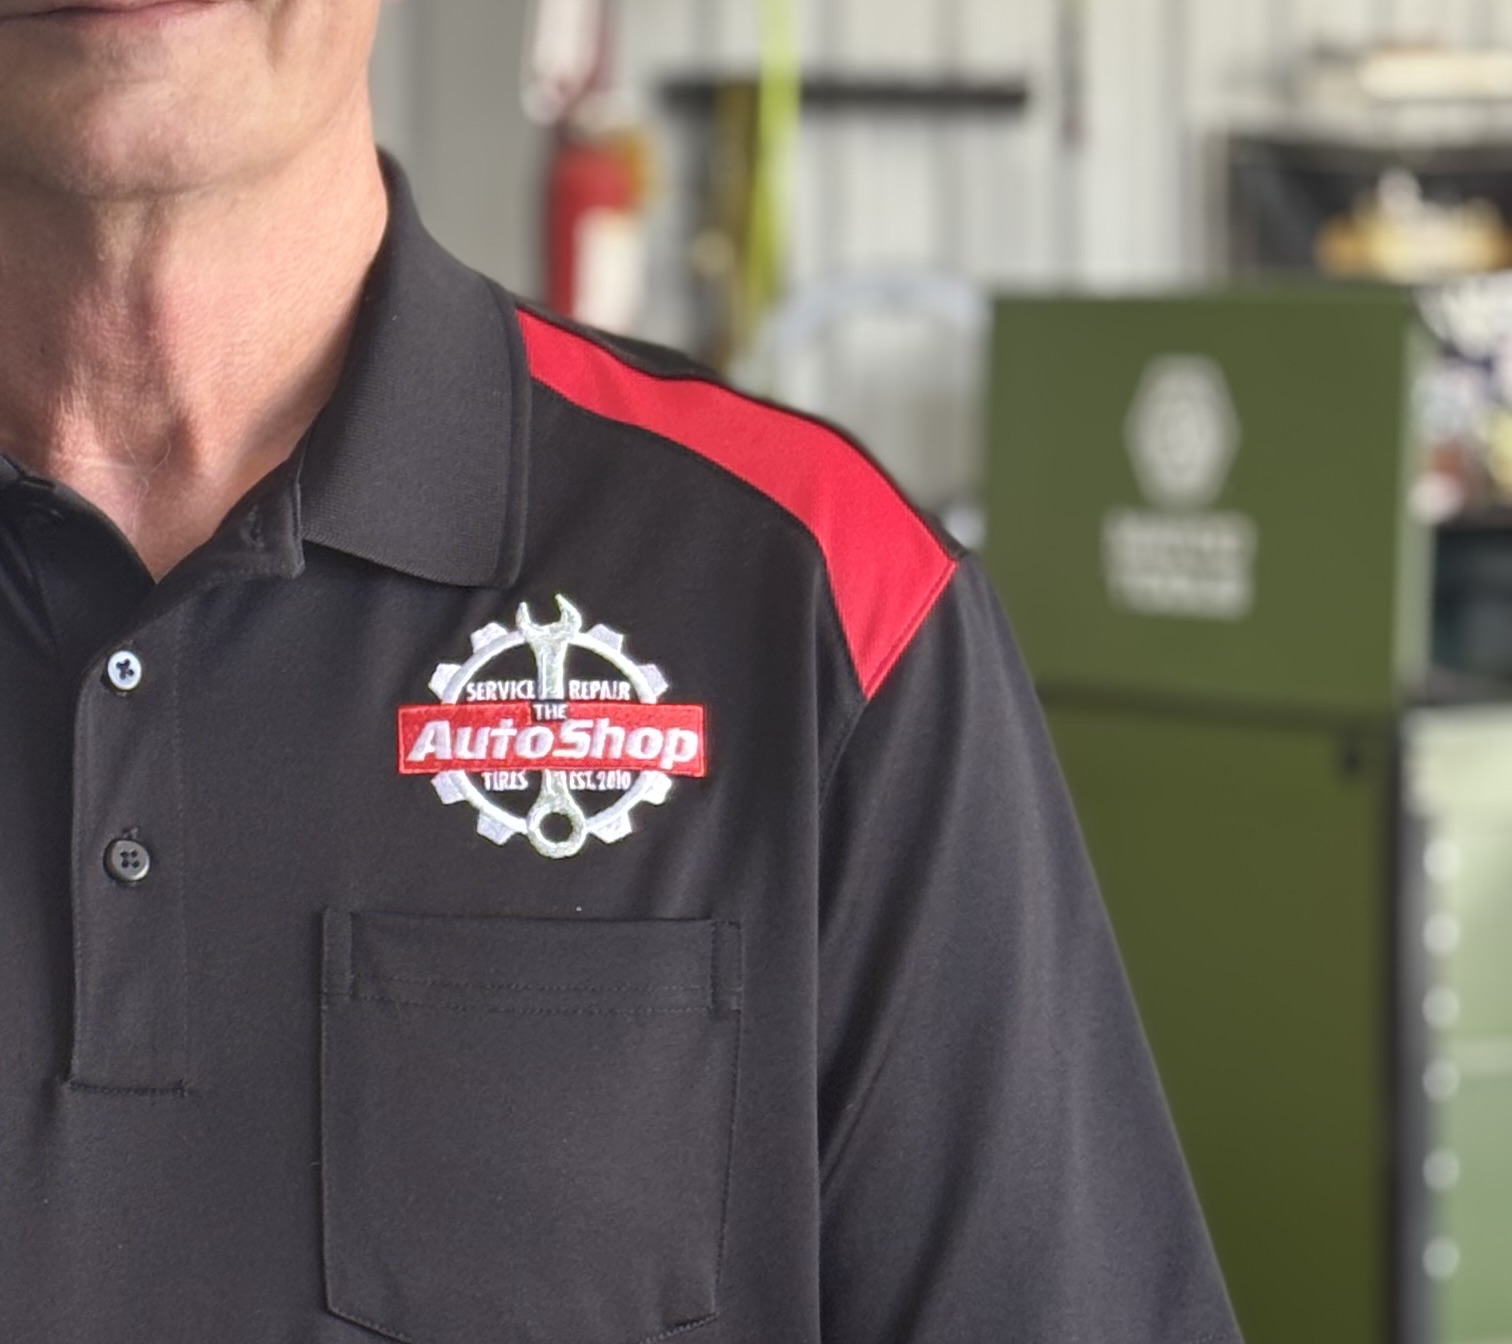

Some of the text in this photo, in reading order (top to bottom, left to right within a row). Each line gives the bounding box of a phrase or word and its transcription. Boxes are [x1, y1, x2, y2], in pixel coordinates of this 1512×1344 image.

[466, 679, 631, 702] SERVICE REPAIR
[533, 703, 568, 720] THE
[406, 718, 699, 770] AutoShop
[481, 770, 529, 791] TIRES
